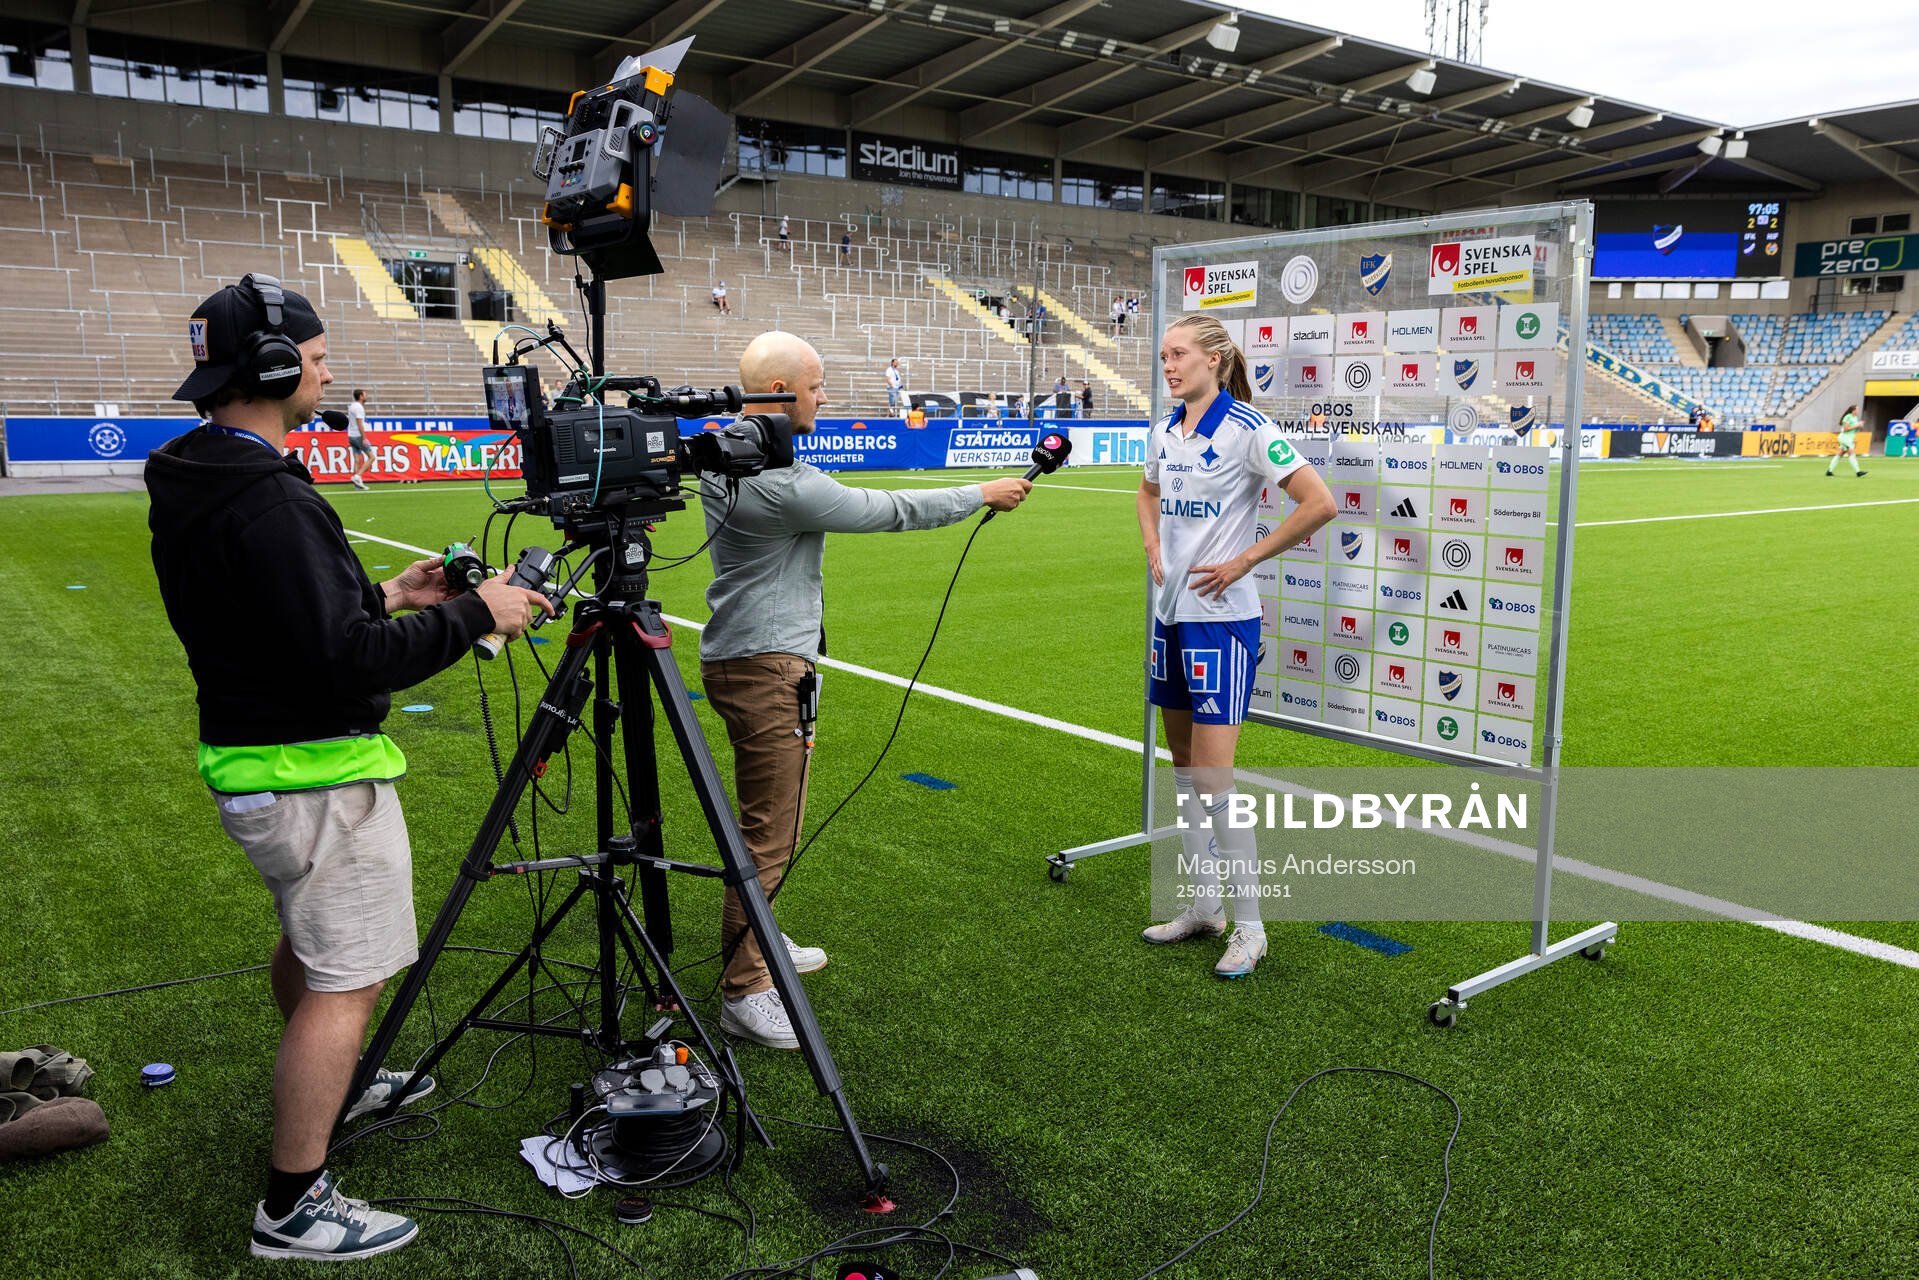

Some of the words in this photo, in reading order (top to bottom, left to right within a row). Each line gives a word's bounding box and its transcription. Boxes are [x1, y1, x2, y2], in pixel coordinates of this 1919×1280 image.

[860, 140, 957, 175] stadium
[912, 171, 923, 180] the
[924, 174, 958, 184] movement
[1748, 203, 1779, 215] 97:05
[1747, 217, 1756, 229] 2
[1770, 217, 1778, 229] 2
[1465, 244, 1532, 261] SVENSKA
[1821, 241, 1865, 259] pre
[1362, 260, 1376, 269] IFK
[1464, 262, 1498, 275] SPEL
[1820, 258, 1879, 274] zero
[1208, 268, 1256, 282] SVENSKA
[1457, 279, 1485, 289] Fotbollens
[1485, 274, 1524, 286] huvudsponsor
[1208, 283, 1232, 294] SPEL
[1293, 330, 1329, 341] stadium
[1392, 326, 1433, 336] HOLMEN
[1311, 403, 1353, 417] OBOS
[1277, 421, 1405, 435] MALLSVENSKAN
[798, 435, 897, 450] LUNDBERGS
[955, 431, 1031, 447] STÅTHÖGA
[1093, 432, 1150, 463] Flin
[798, 453, 865, 463] FASTIGHETER
[953, 451, 1011, 463] VERKSTAD
[1014, 451, 1029, 462] AB
[1336, 456, 1374, 467] stadium
[1166, 463, 1194, 473] stadium
[1400, 460, 1428, 470] OBOS
[1440, 461, 1483, 470] HOLMEN
[1513, 464, 1544, 475] OBOS
[1160, 498, 1221, 518] LMEN
[1493, 508, 1531, 519] Söderbergs
[1532, 511, 1541, 519] Bil
[1298, 578, 1322, 589] OBOS
[1332, 581, 1369, 591] PLATINUMCARS
[1395, 589, 1421, 601] OBOS
[1505, 602, 1536, 614] OBOS
[1284, 615, 1319, 627] HOLMEN
[1434, 647, 1457, 655] SVENSKA
[1487, 643, 1532, 655] PLATINUMCARS
[1380, 681, 1401, 689] SVENSKA
[1252, 687, 1272, 698] dium
[1294, 696, 1318, 708] OBOS
[1487, 699, 1511, 708] SVENSKA
[1389, 714, 1416, 728] OBOS
[1497, 735, 1527, 749] OBOS
